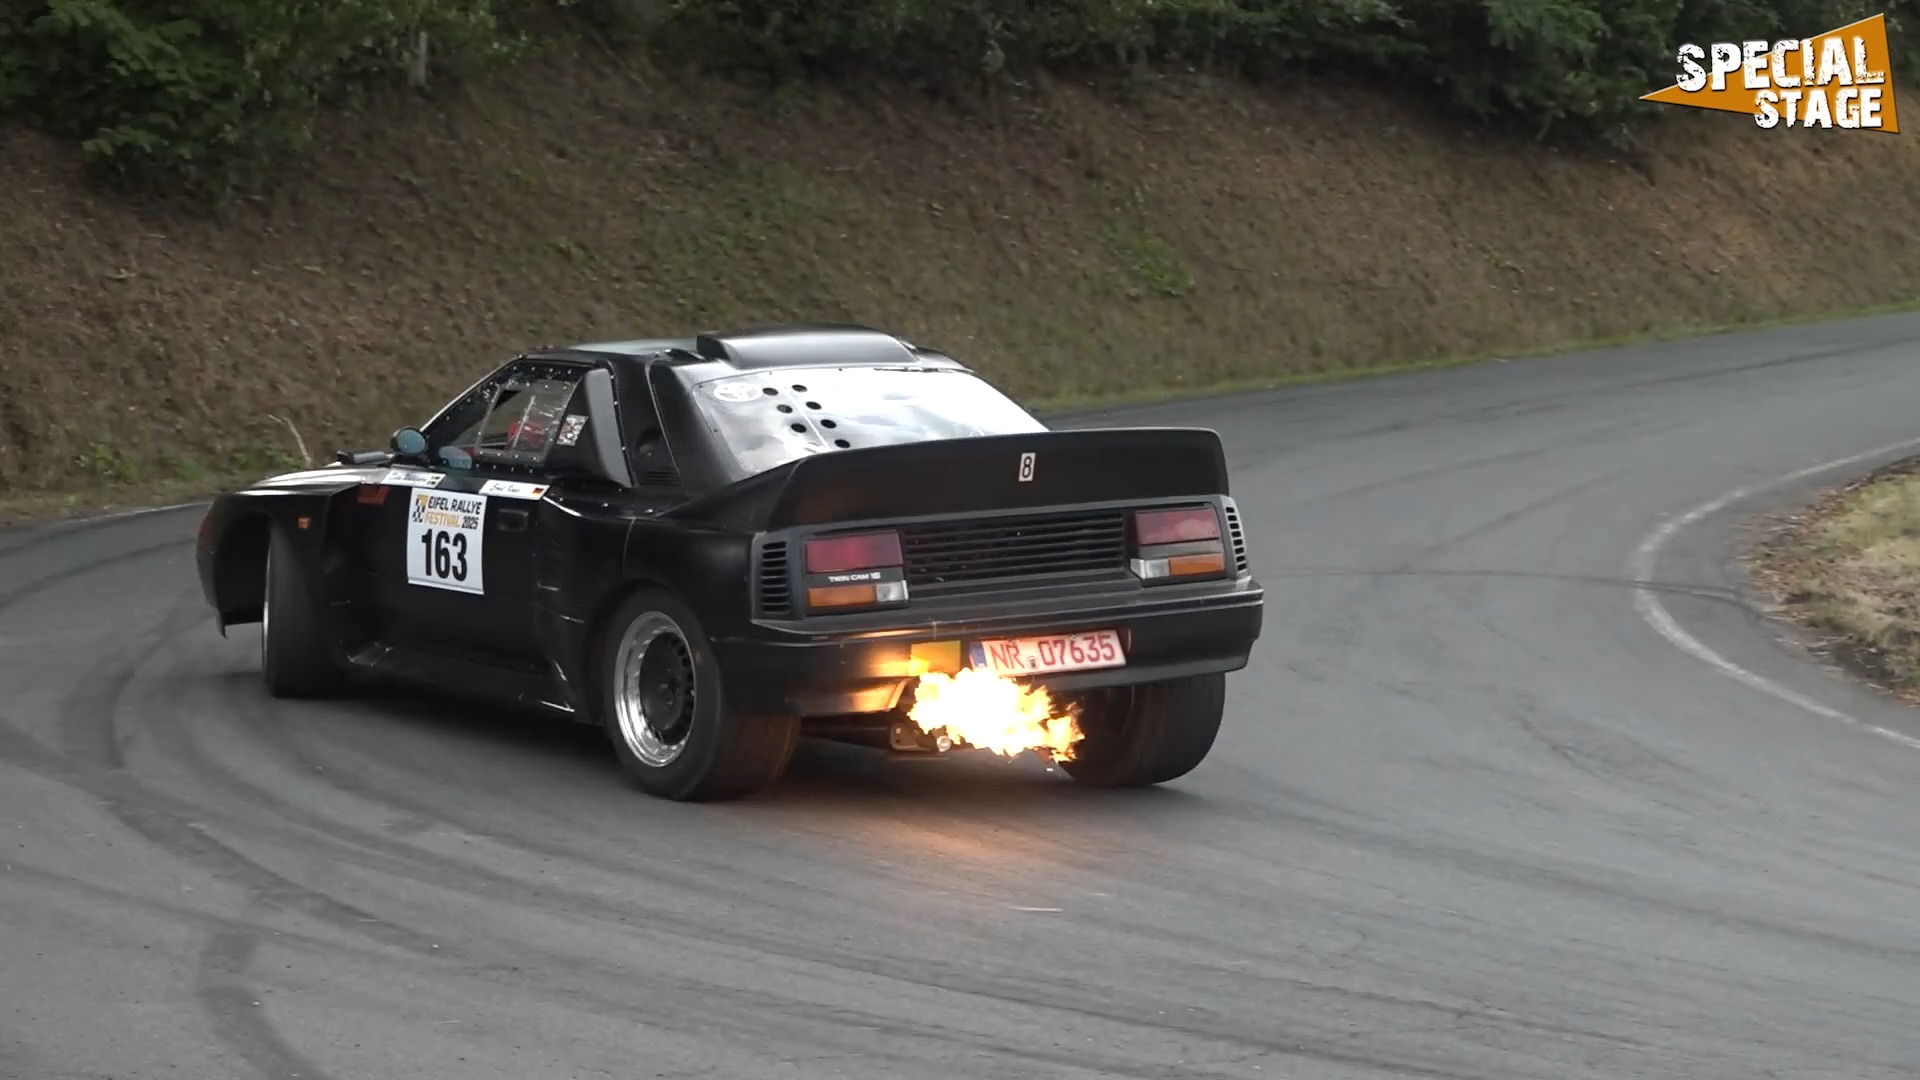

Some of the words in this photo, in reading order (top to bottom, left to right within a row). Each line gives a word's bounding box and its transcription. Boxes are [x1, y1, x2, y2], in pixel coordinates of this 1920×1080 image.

[1021, 455, 1033, 479] 8
[428, 496, 449, 511] EIFEL
[450, 498, 482, 515] RALLYE
[426, 511, 460, 528] FESTIVAL
[461, 515, 479, 530] 2025
[421, 528, 468, 582] 163
[989, 643, 1025, 669] NR
[1038, 634, 1115, 666] 07635
